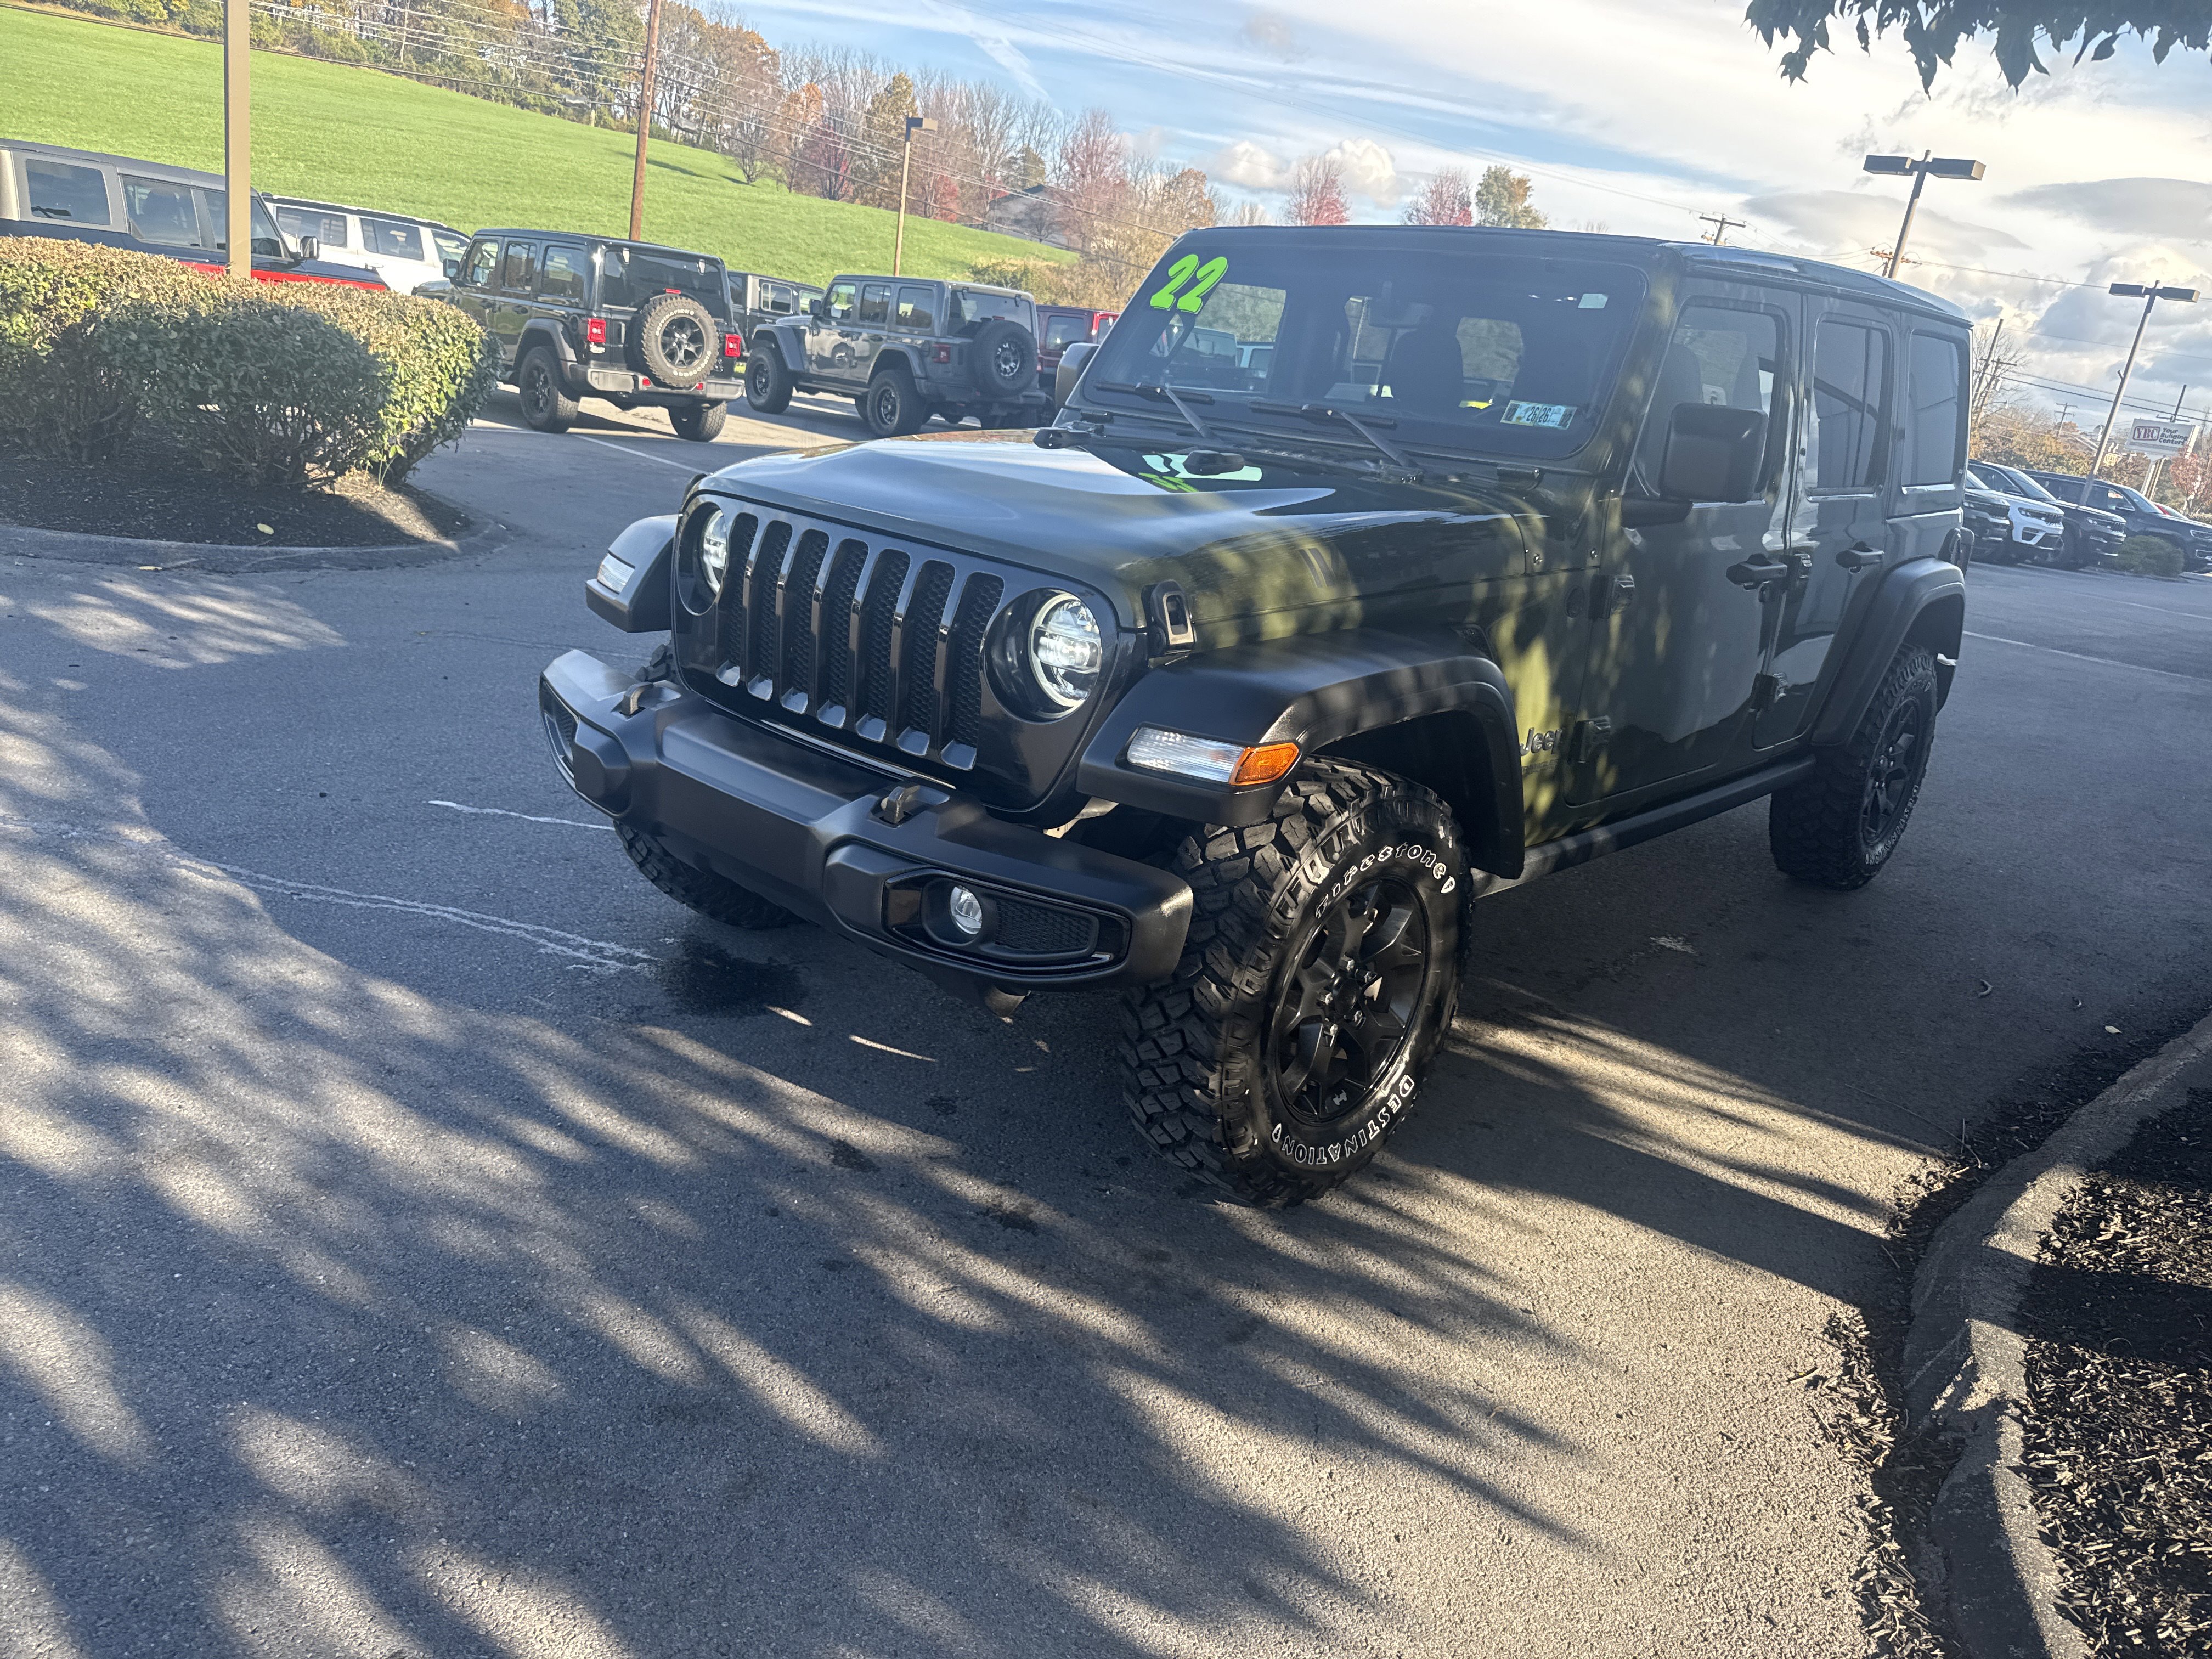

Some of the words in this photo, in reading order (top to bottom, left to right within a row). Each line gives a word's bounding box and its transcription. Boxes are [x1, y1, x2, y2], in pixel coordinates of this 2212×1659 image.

[1150, 254, 1229, 314] 22
[1526, 406, 1539, 422] 26
[1538, 407, 1552, 423] 26
[2136, 428, 2158, 439] YBC
[2159, 433, 2188, 442] Building
[1282, 1074, 1415, 1165] DESTINATION
